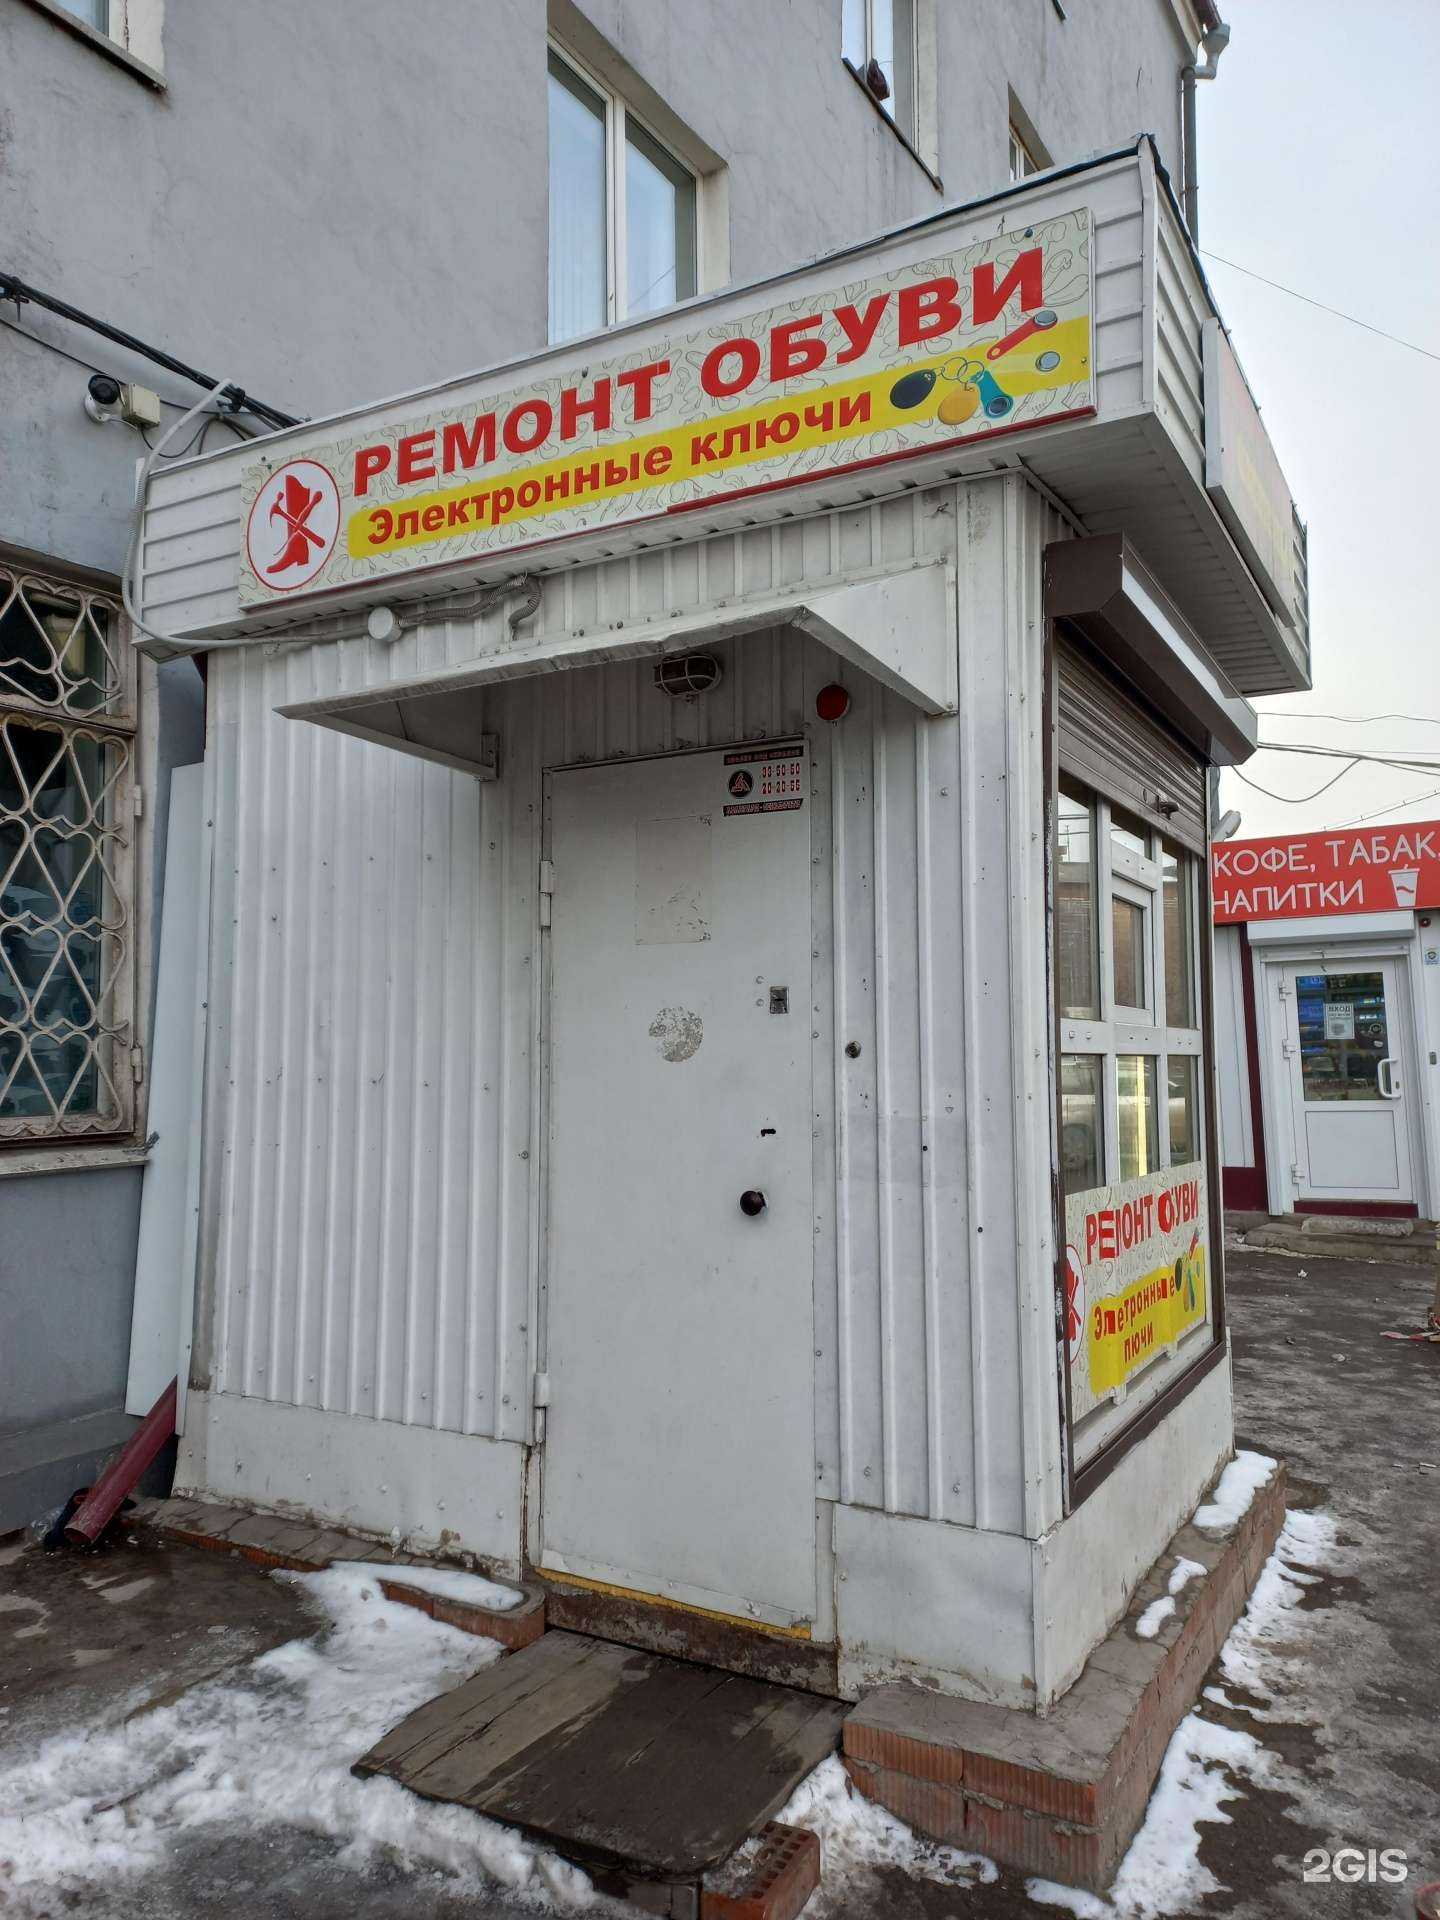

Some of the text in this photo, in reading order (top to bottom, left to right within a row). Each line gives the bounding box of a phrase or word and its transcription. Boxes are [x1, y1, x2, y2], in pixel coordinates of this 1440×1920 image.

[353, 246, 1045, 496] РЕМОНТ ОБУВИ
[367, 391, 871, 545] Электронные ключи
[1213, 843, 1316, 878] КОФЕ,
[1212, 879, 1364, 914] НАПИТКИ
[1157, 1179, 1199, 1234] ОУВИ
